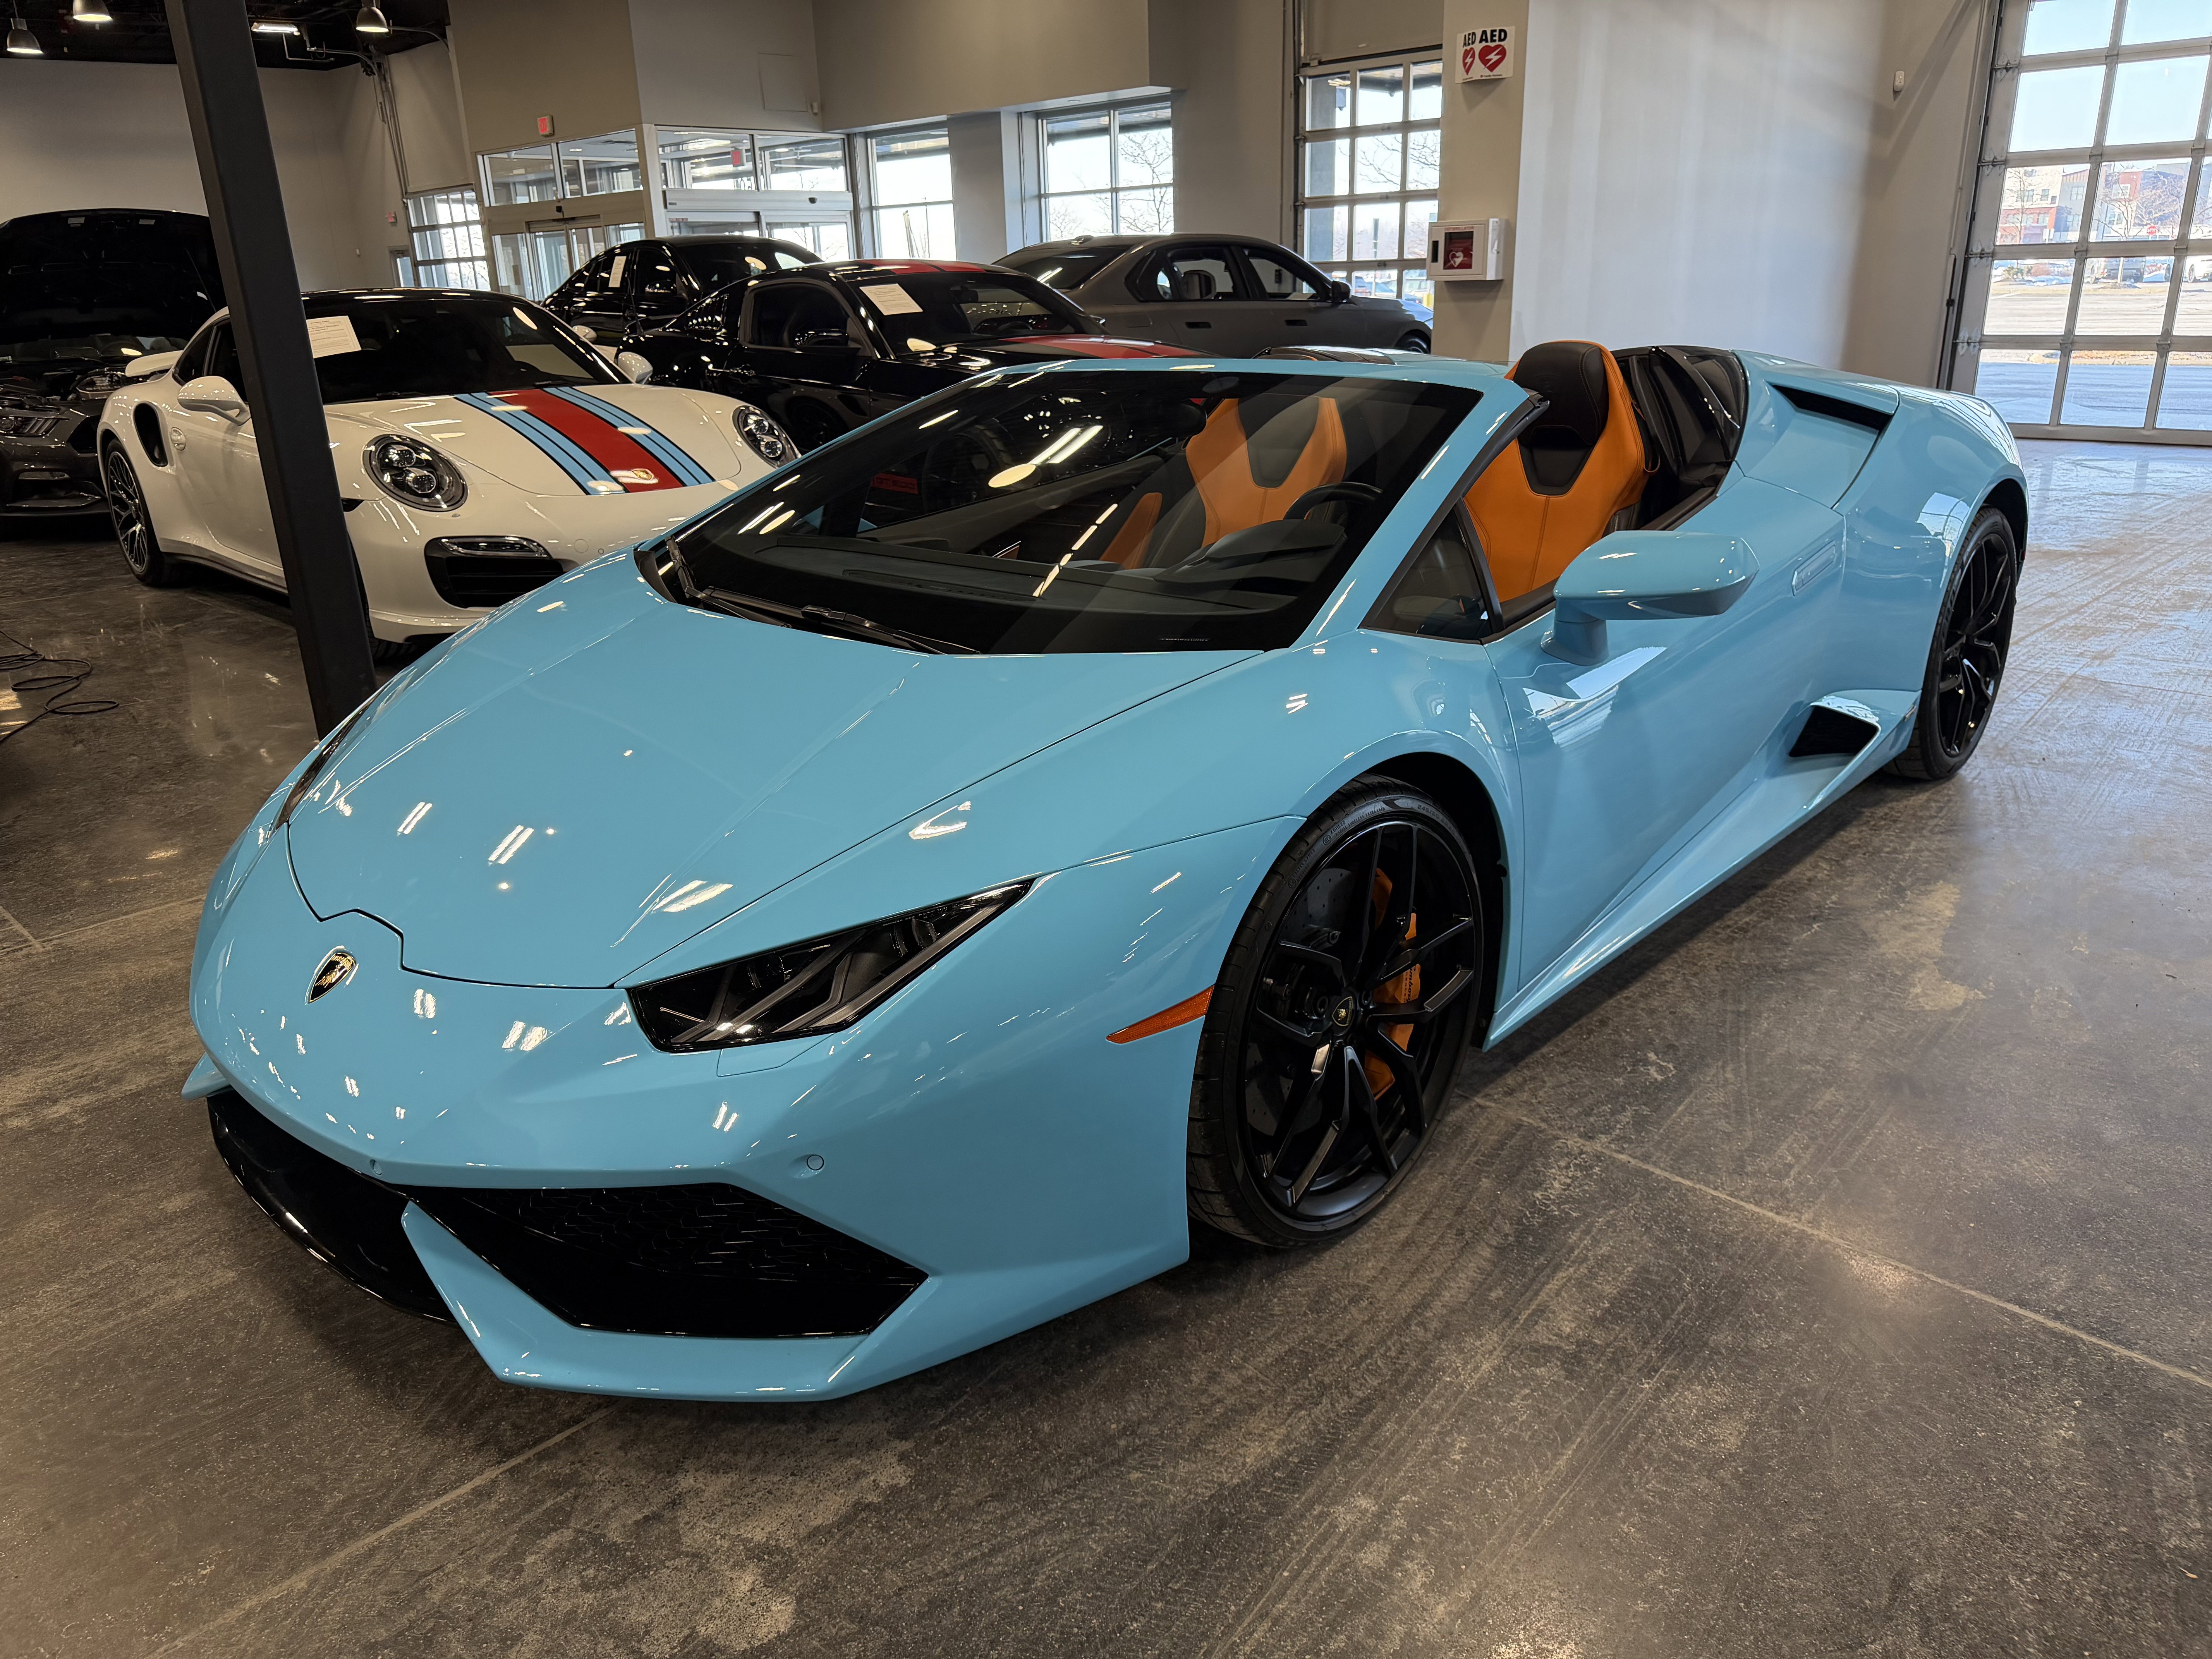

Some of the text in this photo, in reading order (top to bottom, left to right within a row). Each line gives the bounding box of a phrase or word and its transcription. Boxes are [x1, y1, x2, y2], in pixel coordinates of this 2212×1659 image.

[1463, 32, 1476, 48] AED
[1479, 29, 1507, 43] AED
[1348, 815, 1364, 828] TUBELESS
